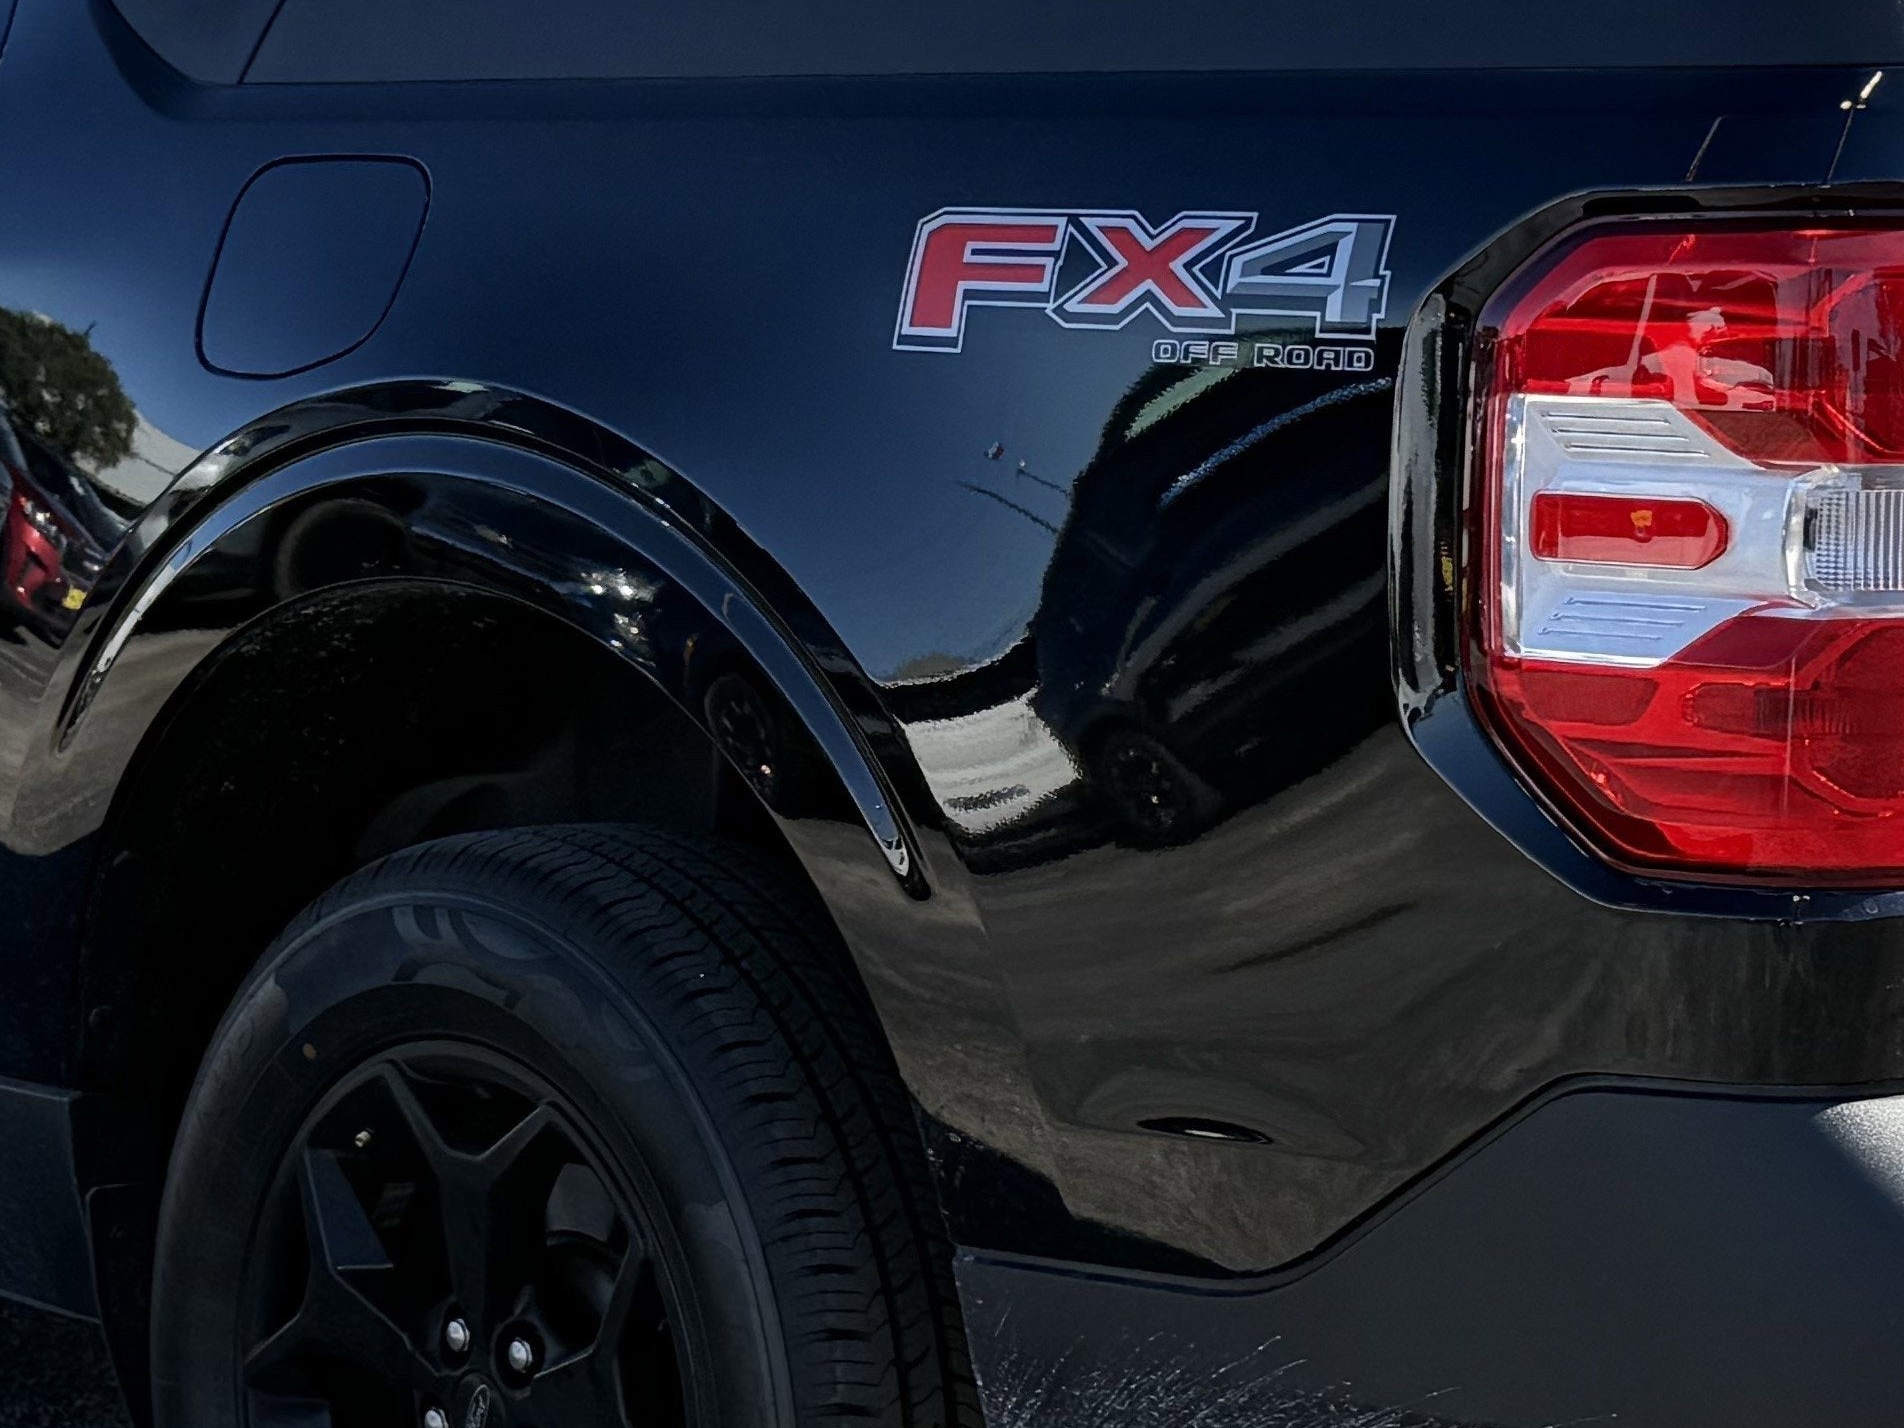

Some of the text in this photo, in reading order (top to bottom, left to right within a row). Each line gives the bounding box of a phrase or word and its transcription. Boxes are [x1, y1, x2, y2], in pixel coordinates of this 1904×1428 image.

[893, 207, 1396, 353] FX4
[1151, 338, 1376, 372] OFF ROAD
